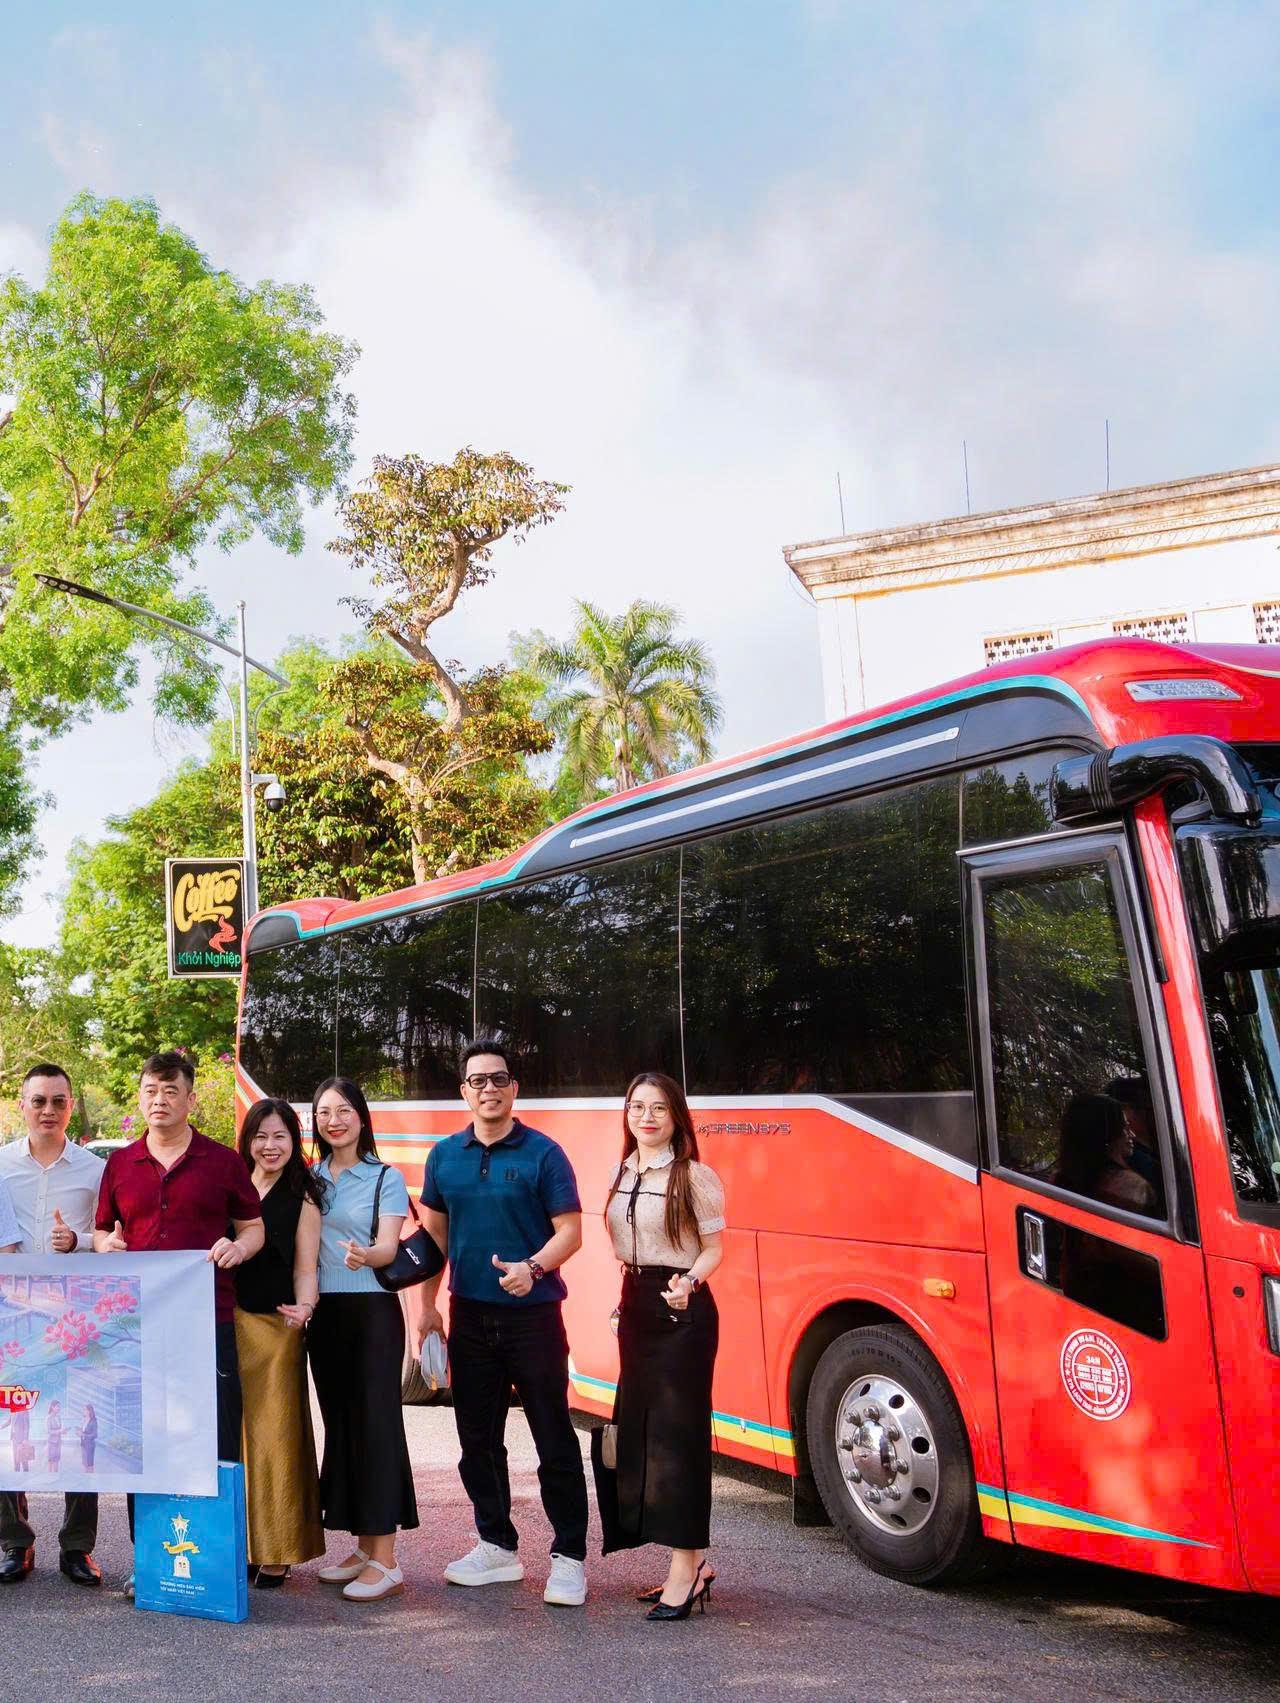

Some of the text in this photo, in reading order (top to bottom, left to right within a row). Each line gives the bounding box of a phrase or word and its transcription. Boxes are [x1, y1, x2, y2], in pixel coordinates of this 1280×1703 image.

[174, 869, 240, 932] Coffee
[178, 951, 241, 968] Khởi Nghiệp
